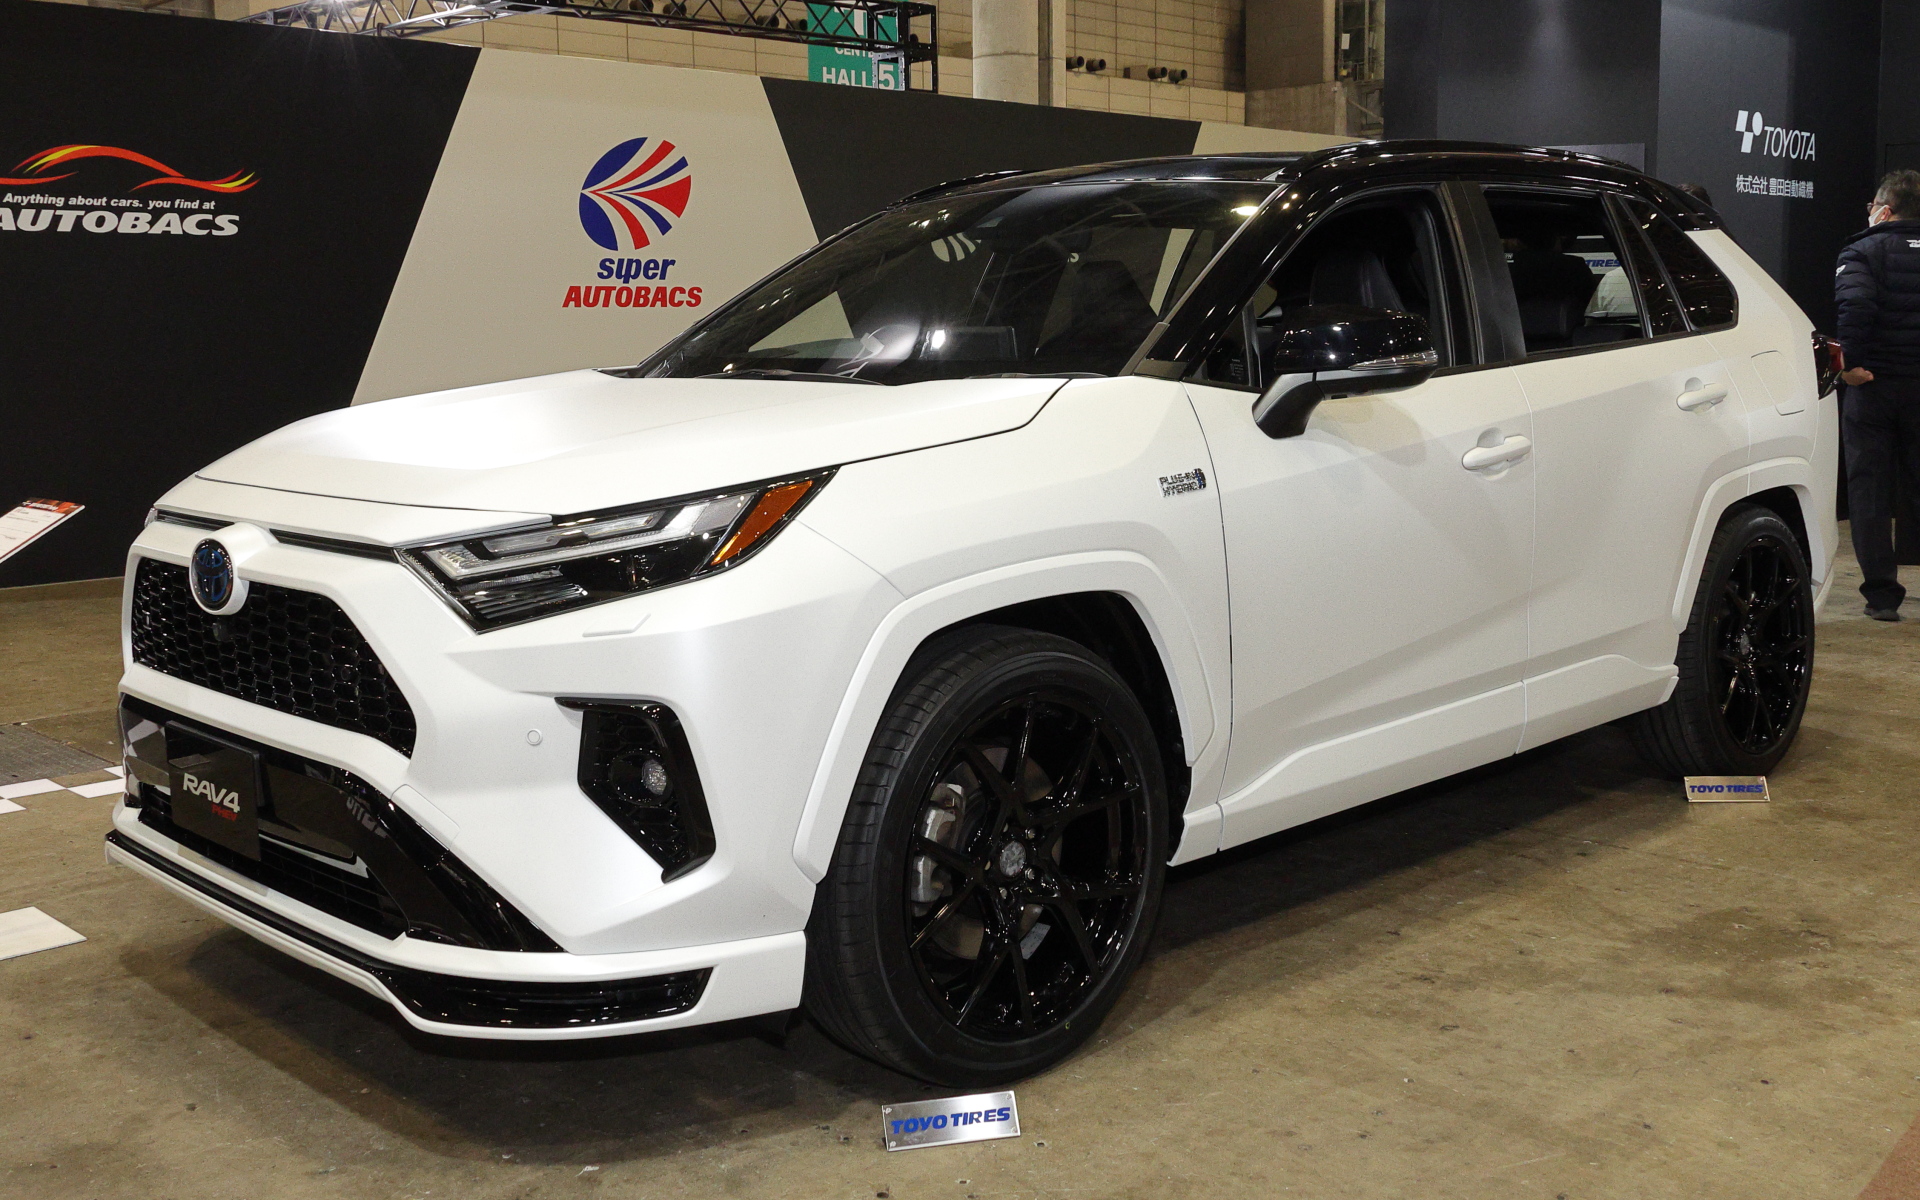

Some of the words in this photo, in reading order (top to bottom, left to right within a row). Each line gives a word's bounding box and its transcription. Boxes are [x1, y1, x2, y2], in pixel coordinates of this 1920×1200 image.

[822, 66, 873, 88] HALL
[878, 63, 895, 90] 5
[1764, 126, 1815, 161] TOYOTA
[4, 193, 64, 206] Anything
[69, 195, 107, 206] about
[110, 198, 143, 208] cars.
[148, 200, 171, 209] you
[174, 199, 199, 210] find
[202, 200, 216, 210] at
[597, 258, 676, 284] super
[562, 286, 702, 308] AUTOBACS
[183, 773, 240, 813] RAV4
[1690, 785, 1724, 793] TOYO
[1726, 785, 1763, 793] TIRES
[891, 1114, 947, 1134] TOYO
[951, 1107, 1010, 1127] TIRES
